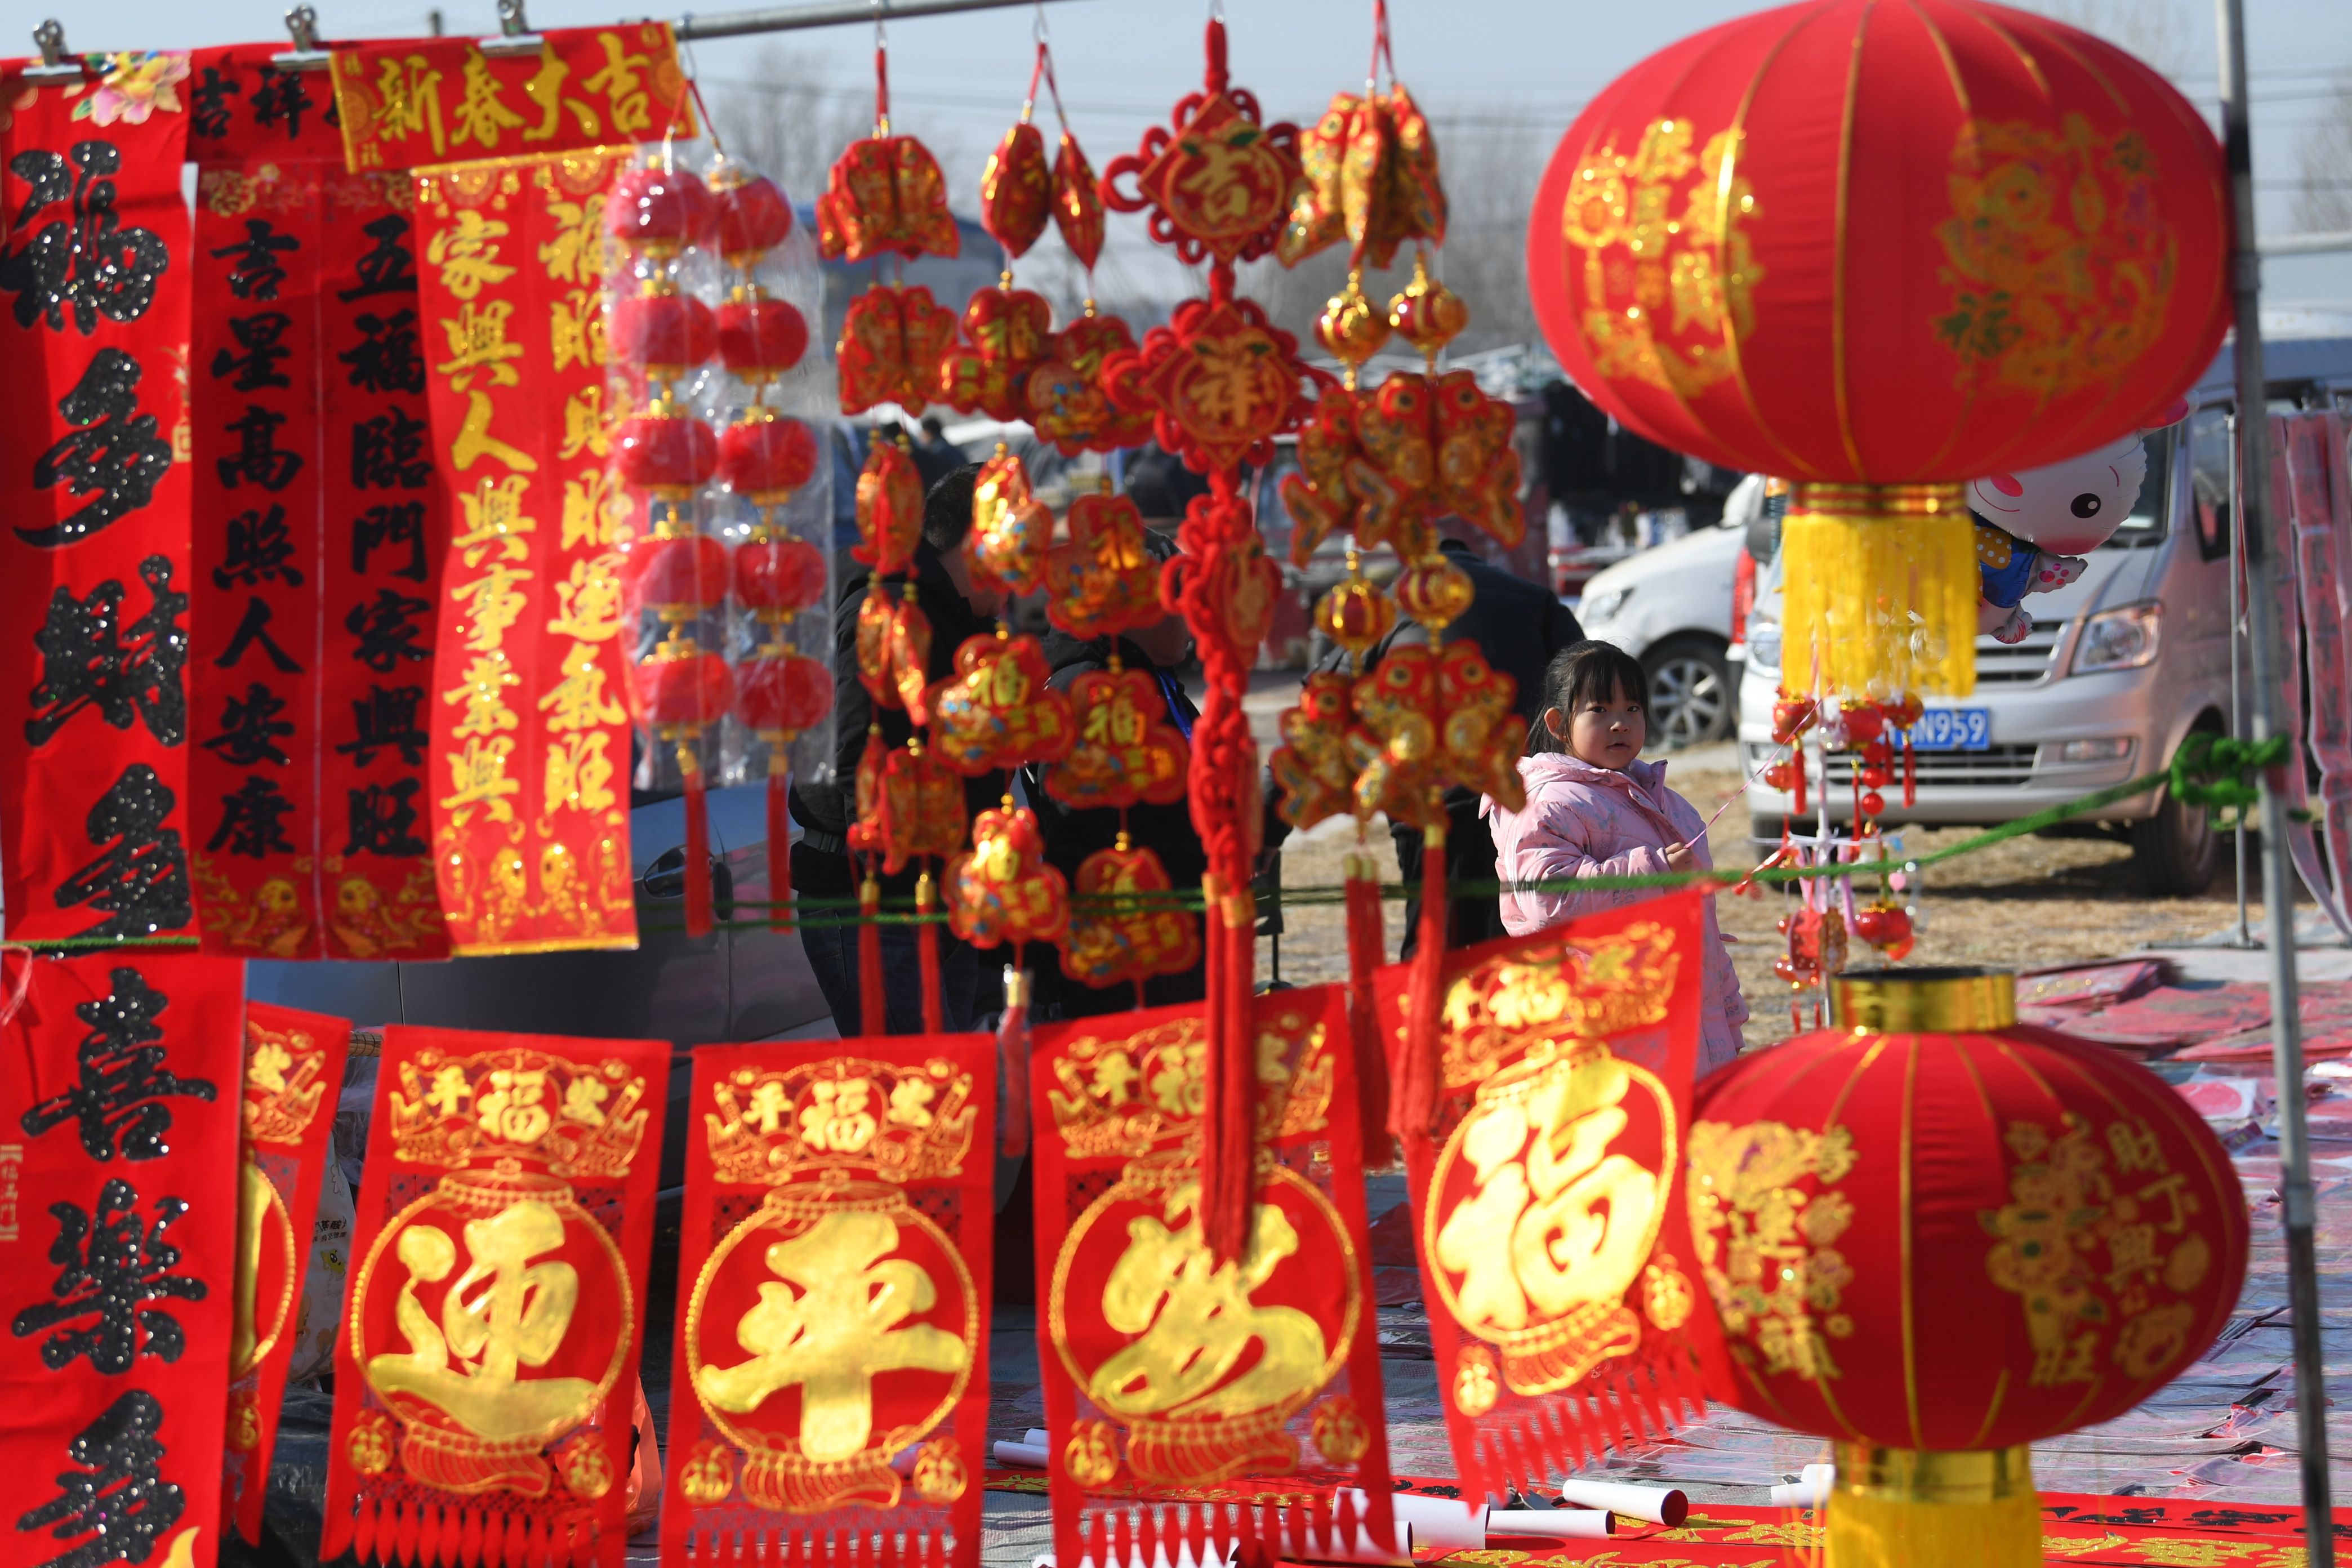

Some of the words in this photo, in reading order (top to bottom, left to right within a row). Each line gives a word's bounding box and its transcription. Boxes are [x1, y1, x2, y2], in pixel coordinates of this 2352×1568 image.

[189, 65, 341, 139] 吉祥
[372, 33, 653, 157] 新春大吉
[1181, 145, 1253, 222] 吉
[201, 219, 305, 858] 吉星高照人安康
[1906, 711, 1986, 745] N959
[1437, 1057, 1659, 1332] 福
[698, 1209, 968, 1463] 平
